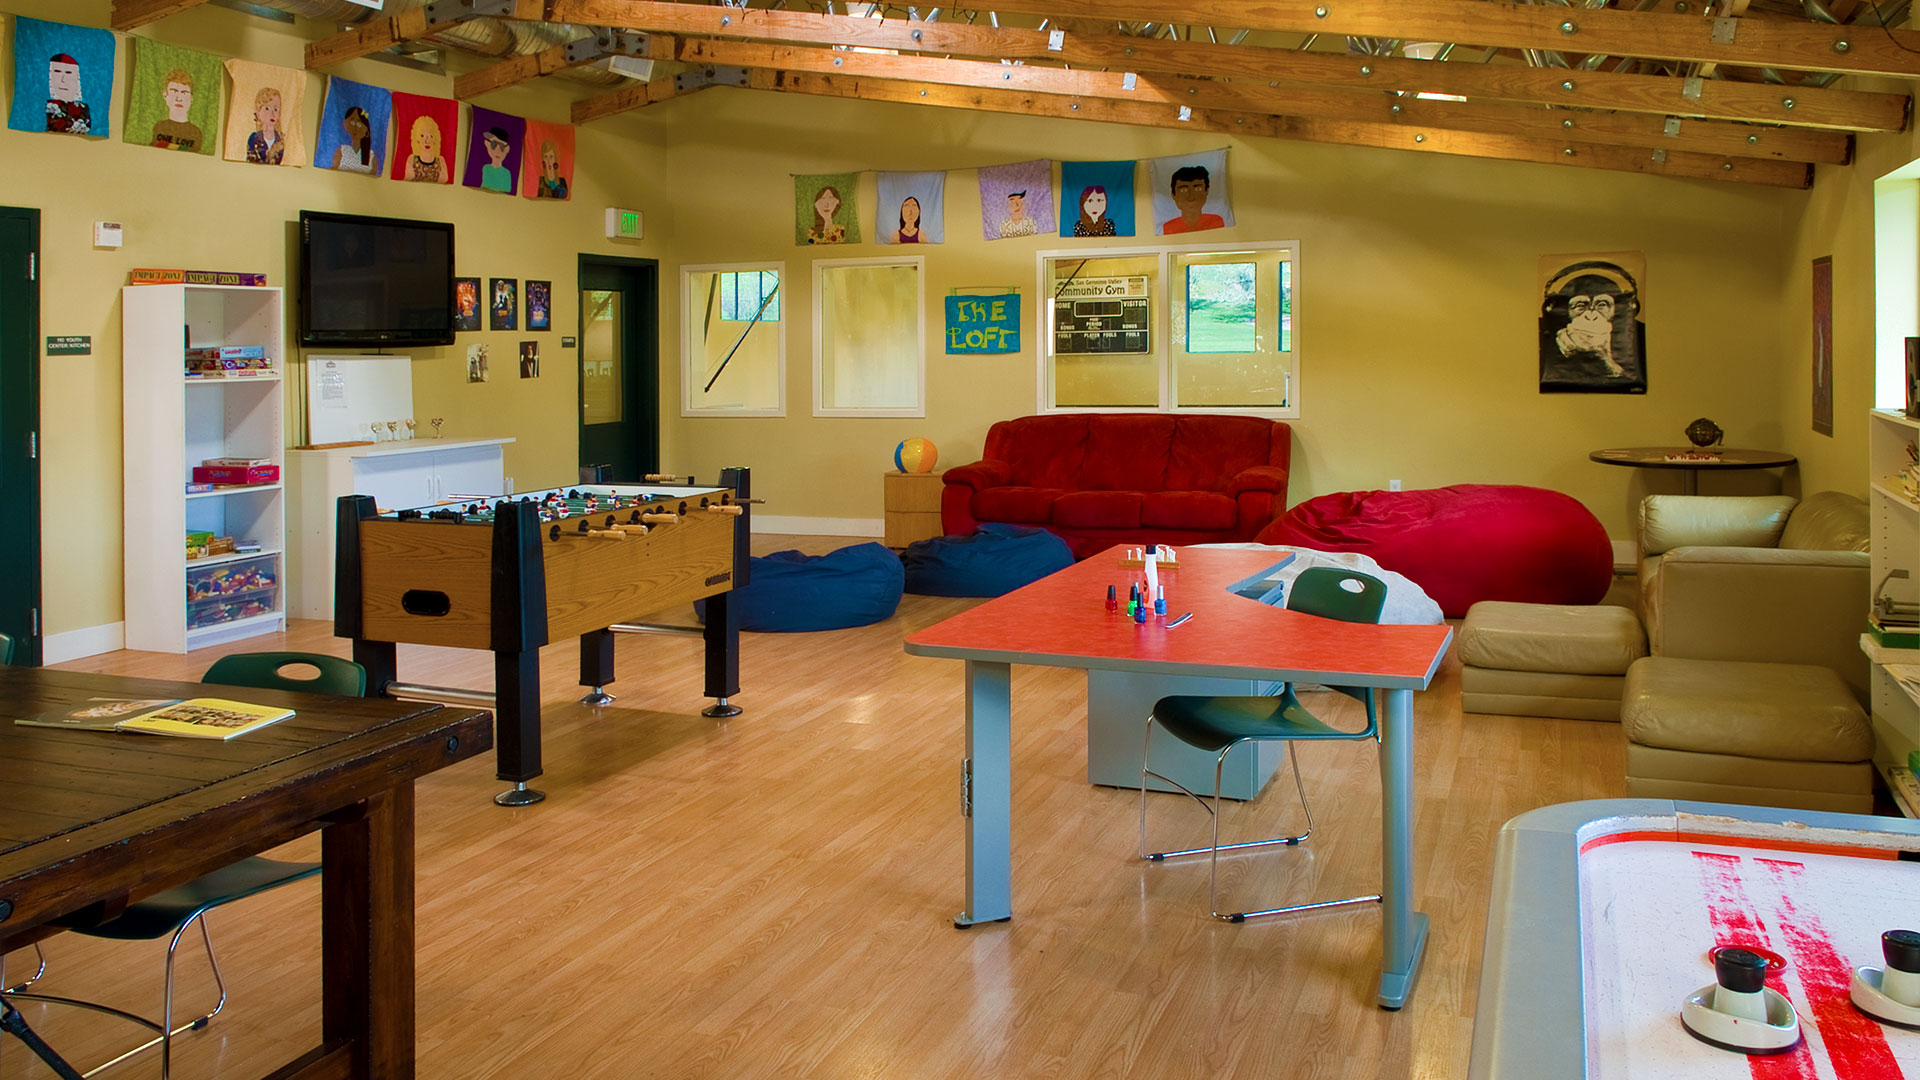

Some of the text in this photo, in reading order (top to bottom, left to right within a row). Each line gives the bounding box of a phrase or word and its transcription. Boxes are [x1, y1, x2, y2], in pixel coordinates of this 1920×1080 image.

[157, 133, 195, 147] ONE LOVE
[621, 212, 638, 235] EXIT
[134, 270, 182, 281] IMPACT ZONE
[187, 273, 240, 284] IMPACT ZONE
[1055, 284, 1126, 297] Community Gym
[957, 299, 1007, 322] THE
[1123, 300, 1147, 308] VISITOR
[946, 326, 1018, 348] LOFT
